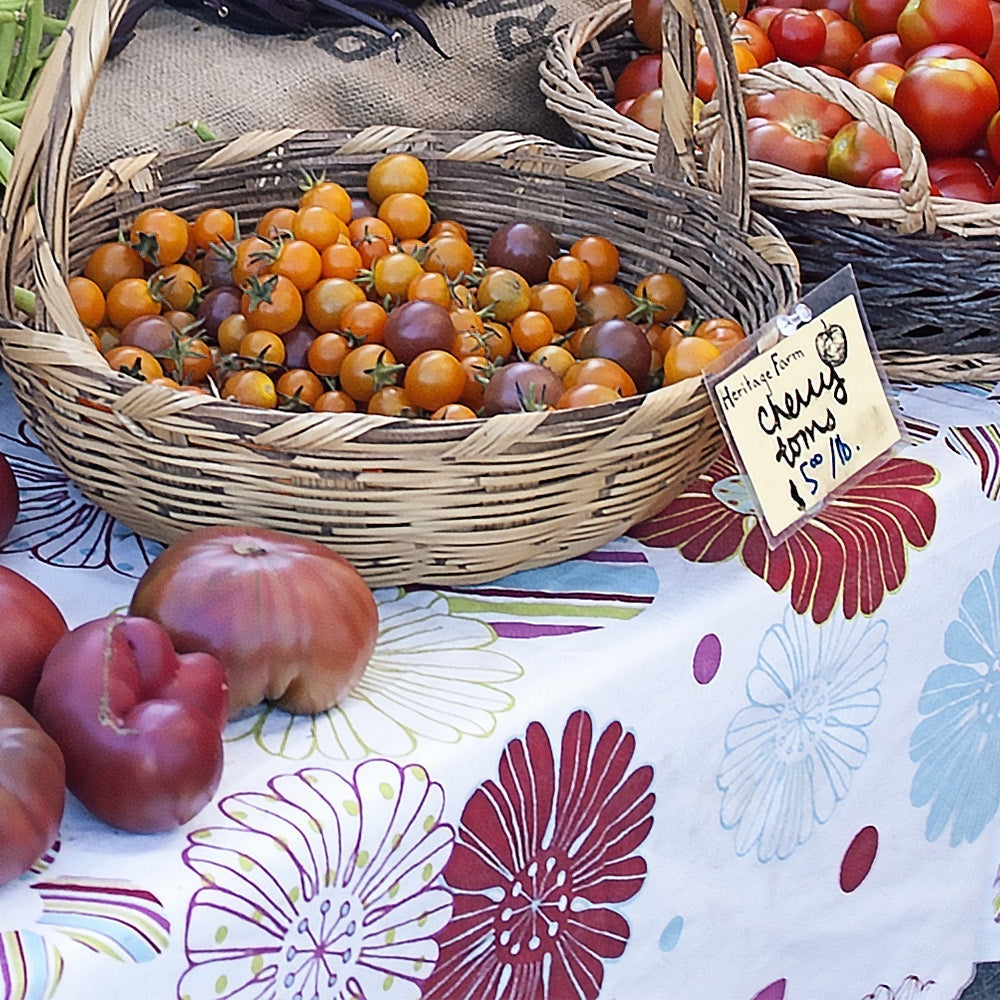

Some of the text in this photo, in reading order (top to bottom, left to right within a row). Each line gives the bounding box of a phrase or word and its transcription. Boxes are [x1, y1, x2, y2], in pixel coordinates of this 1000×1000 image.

[718, 349, 805, 411] Heritage Farm
[775, 408, 837, 468] toms
